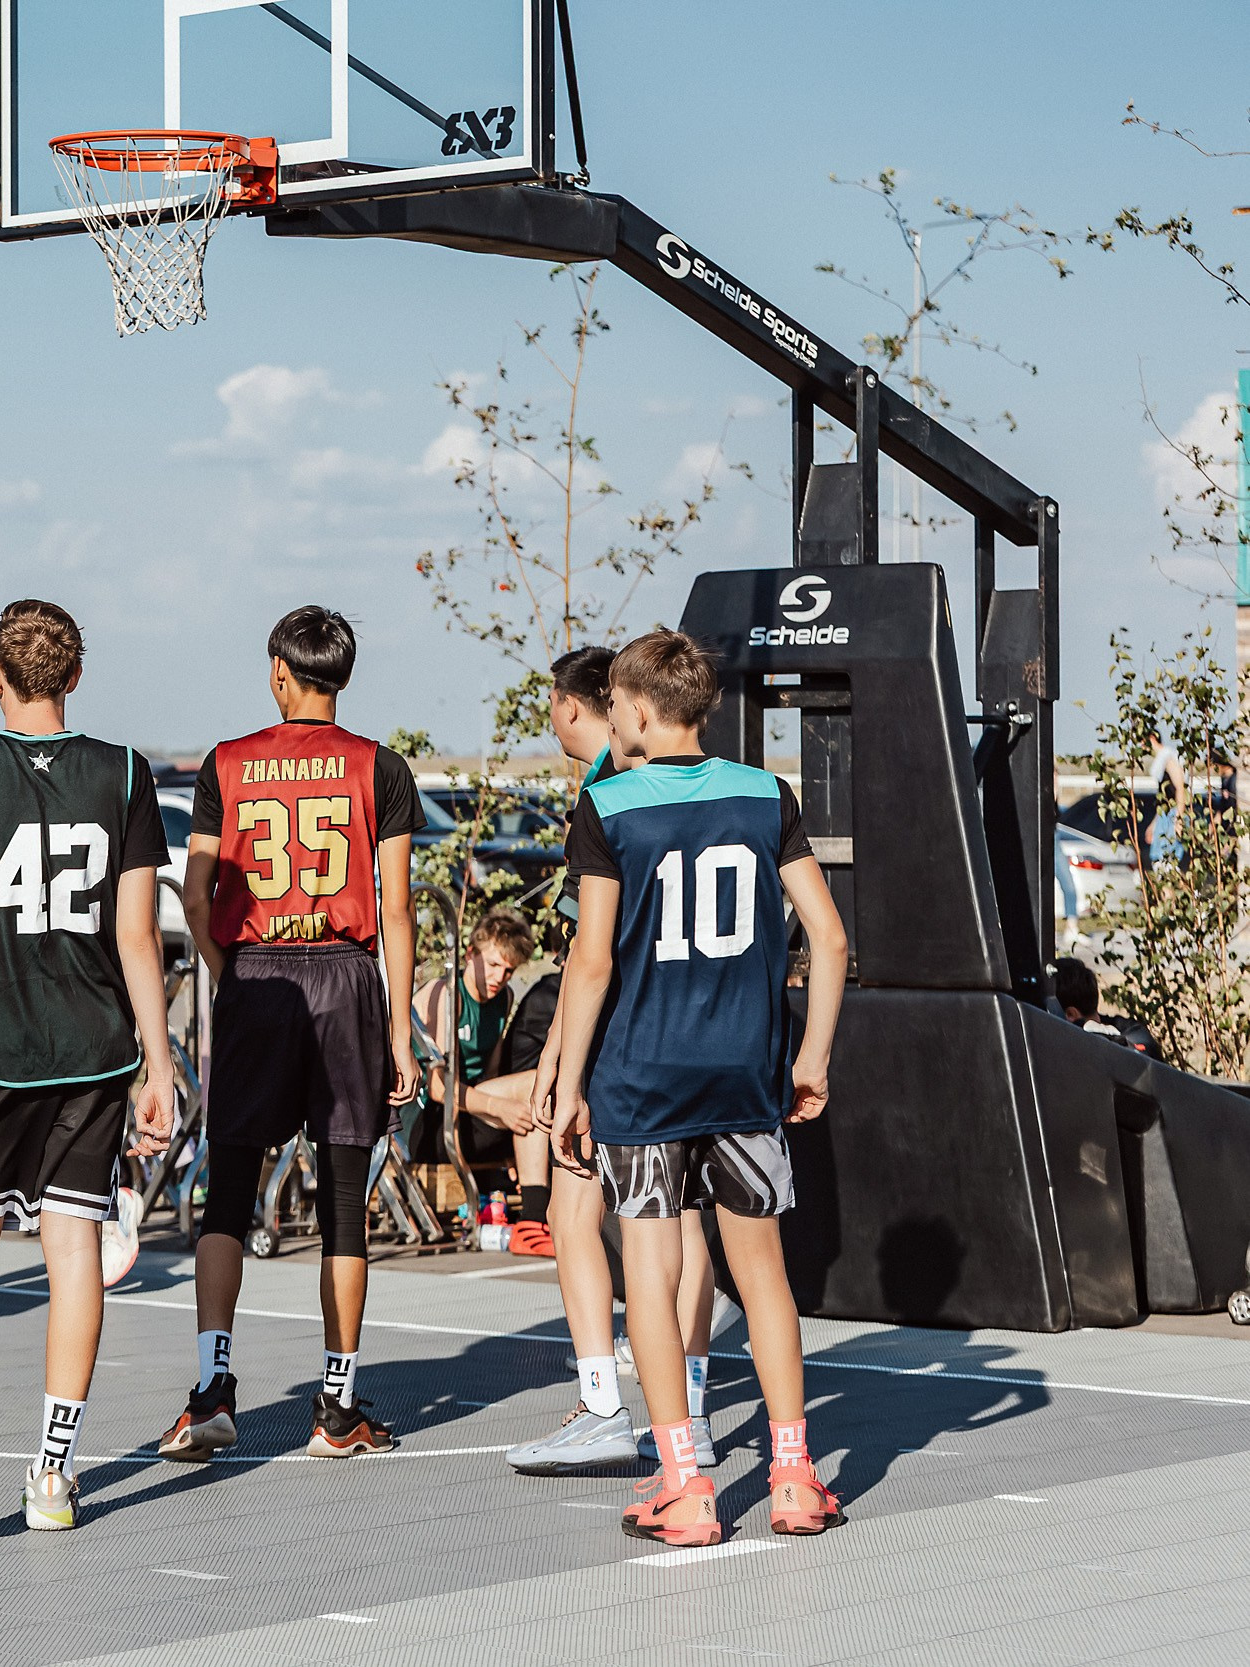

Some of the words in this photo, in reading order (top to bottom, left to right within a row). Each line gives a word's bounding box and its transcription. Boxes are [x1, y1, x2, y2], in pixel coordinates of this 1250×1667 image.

[692, 257, 762, 320] Schelde
[762, 307, 819, 360] Sports
[748, 624, 850, 646] Schelde
[241, 756, 346, 785] ZHANABAI
[237, 796, 352, 901] 35
[261, 911, 328, 943] JUMP
[655, 843, 758, 963] 10
